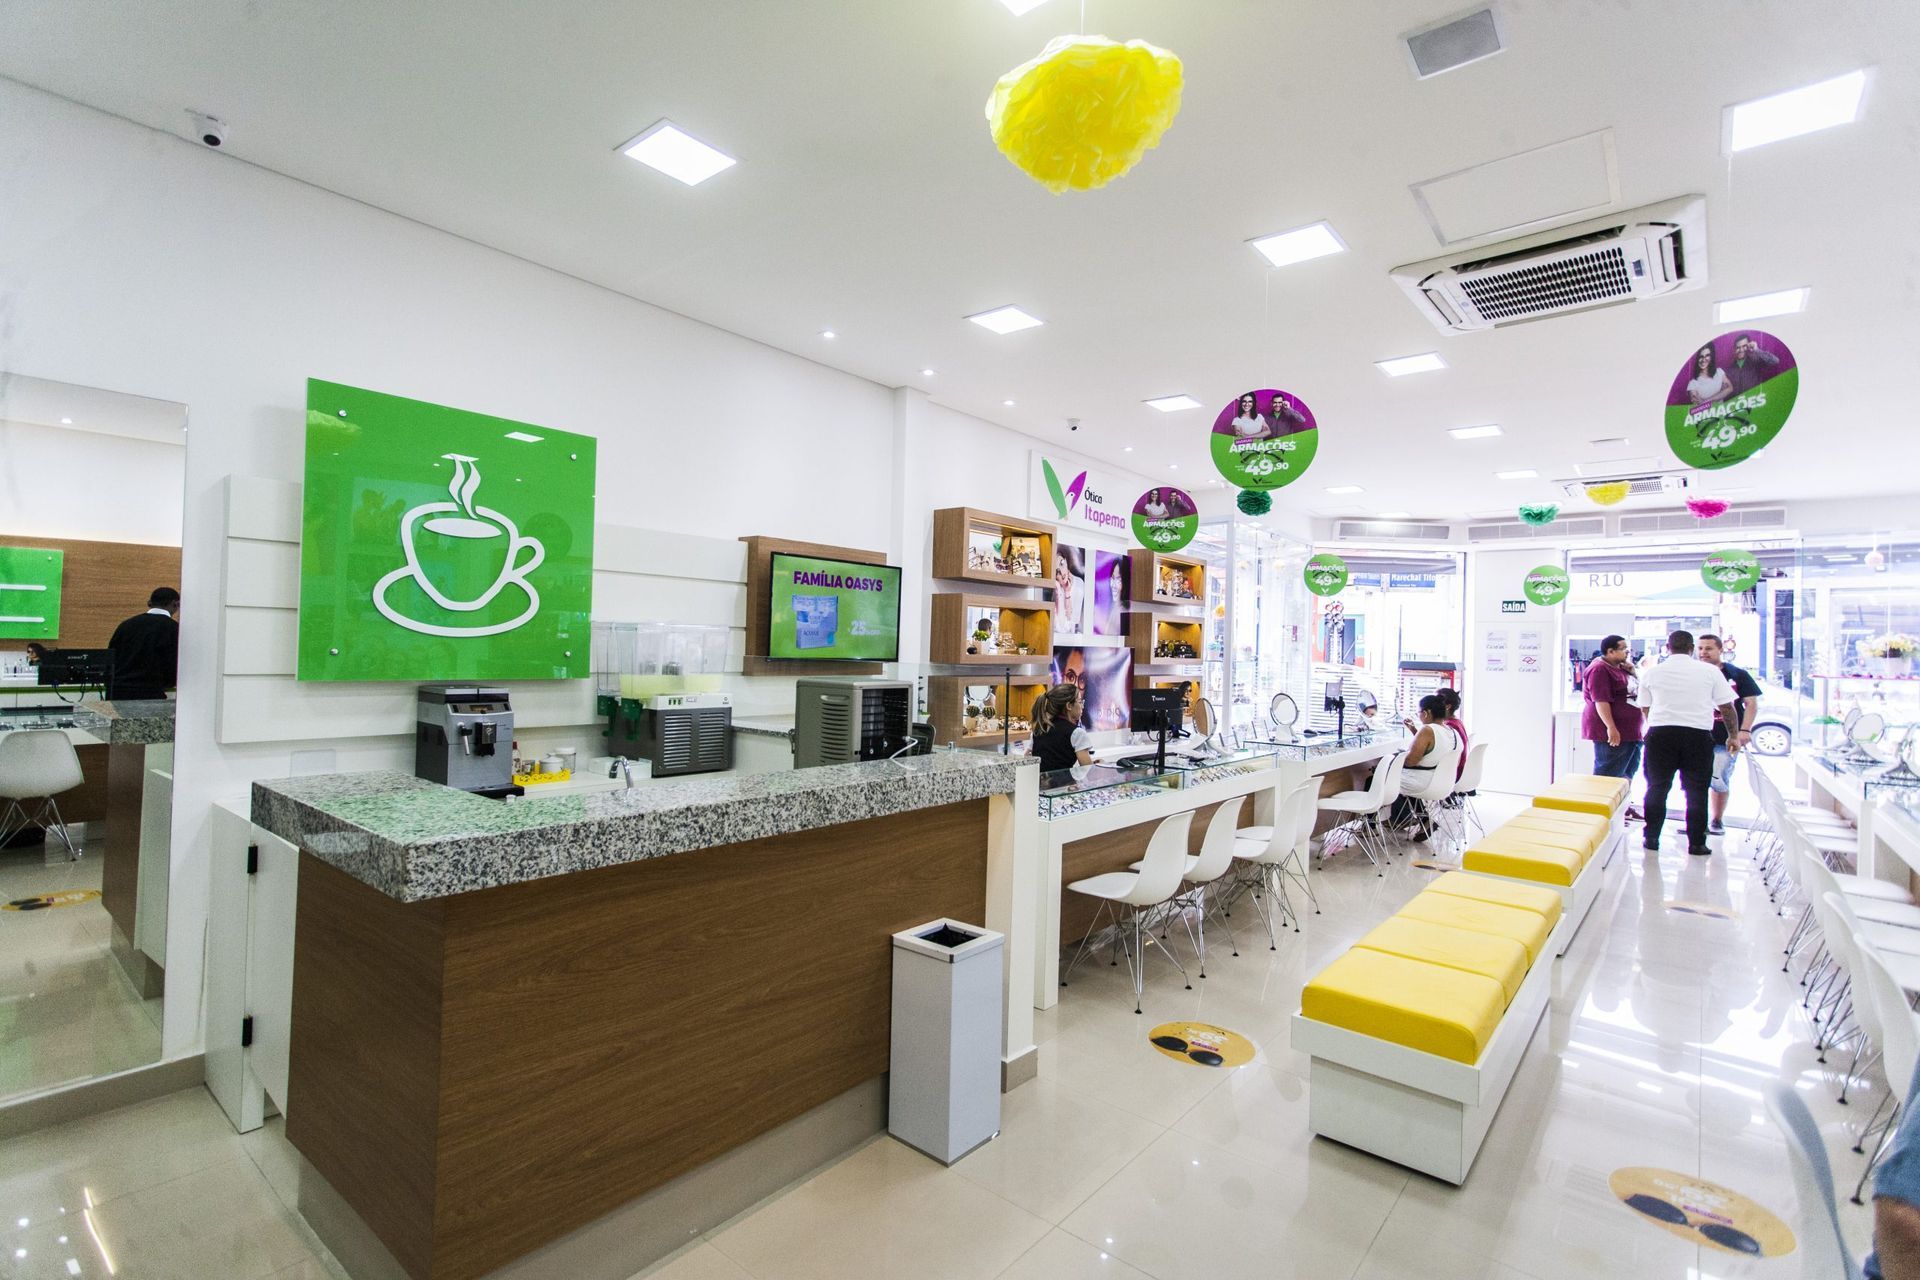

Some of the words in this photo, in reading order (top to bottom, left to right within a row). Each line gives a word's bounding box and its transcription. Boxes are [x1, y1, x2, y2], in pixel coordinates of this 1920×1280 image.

[1684, 393, 1767, 427] ARMAÇÕES
[1229, 439, 1296, 453] ARMAÇÕES
[1084, 487, 1103, 504] Ótica
[1085, 503, 1126, 529] Itapema
[793, 570, 843, 588] FAMÍLIA
[845, 576, 883, 592] OASYS
[1502, 601, 1526, 611] SAÍDA
